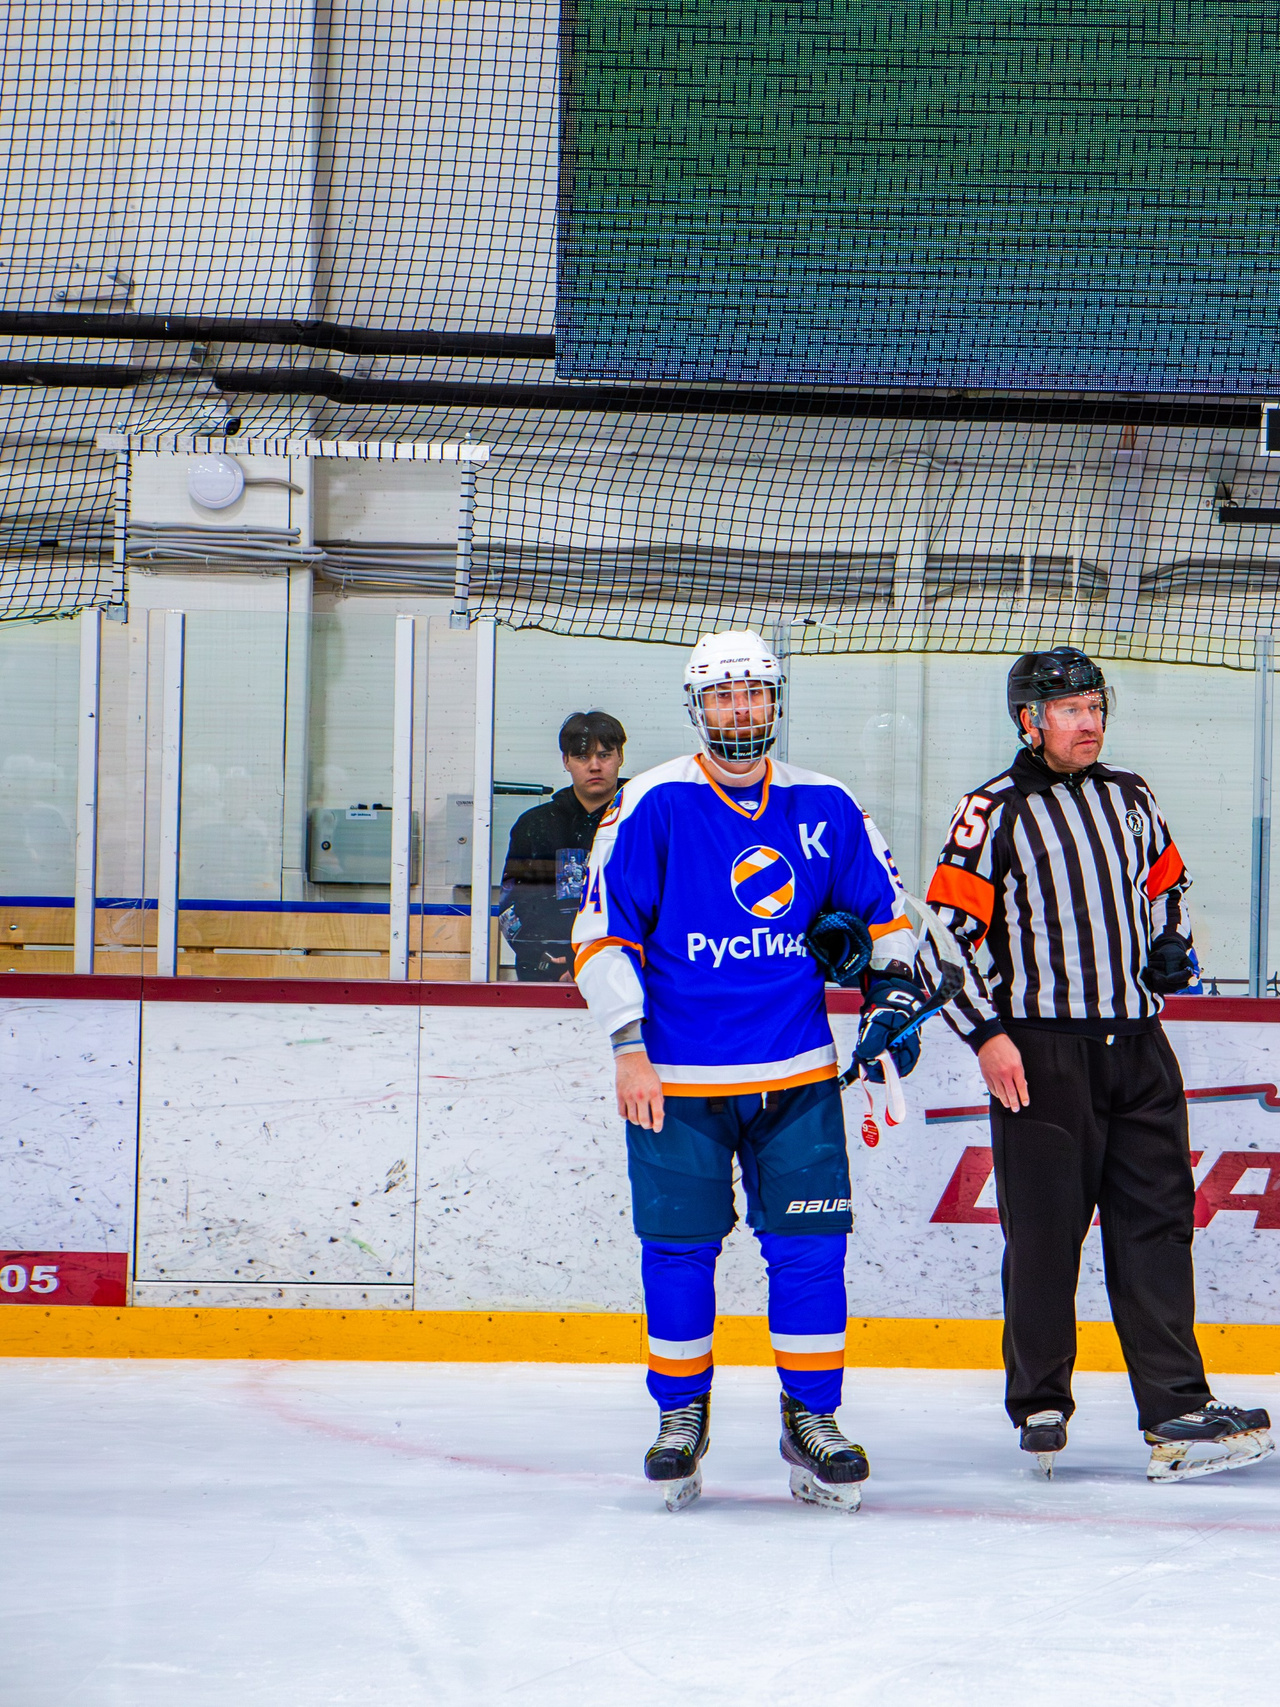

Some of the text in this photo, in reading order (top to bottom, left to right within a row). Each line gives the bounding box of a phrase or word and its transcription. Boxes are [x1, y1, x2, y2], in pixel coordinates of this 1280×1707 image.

[687, 927, 808, 969] РусГид
[785, 1198, 852, 1215] BAUER
[0, 1264, 60, 1294] 05
